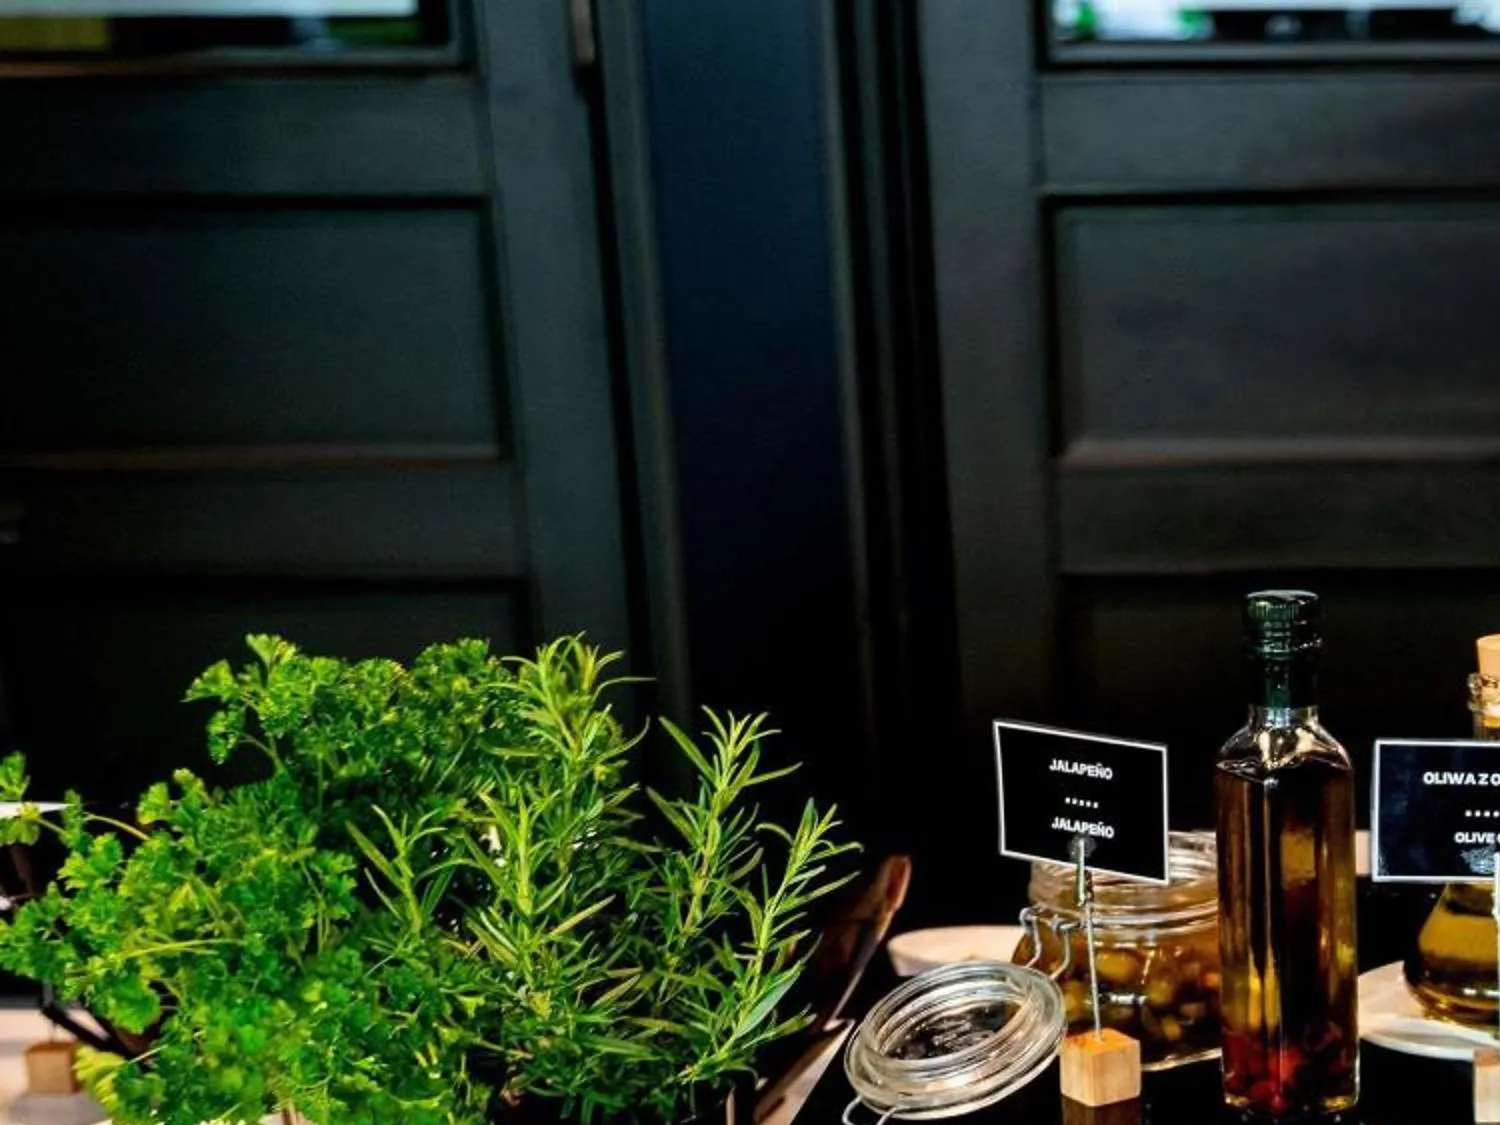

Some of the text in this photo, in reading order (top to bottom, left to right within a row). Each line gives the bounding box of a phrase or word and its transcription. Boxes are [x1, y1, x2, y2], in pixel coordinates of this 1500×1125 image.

[1050, 758, 1113, 780] JALAPEÑO
[1423, 771, 1476, 785] OLIWA
[1478, 773, 1488, 785] Z
[1052, 817, 1115, 839] JALAPEÑO
[1454, 832, 1494, 844] OLIVE
